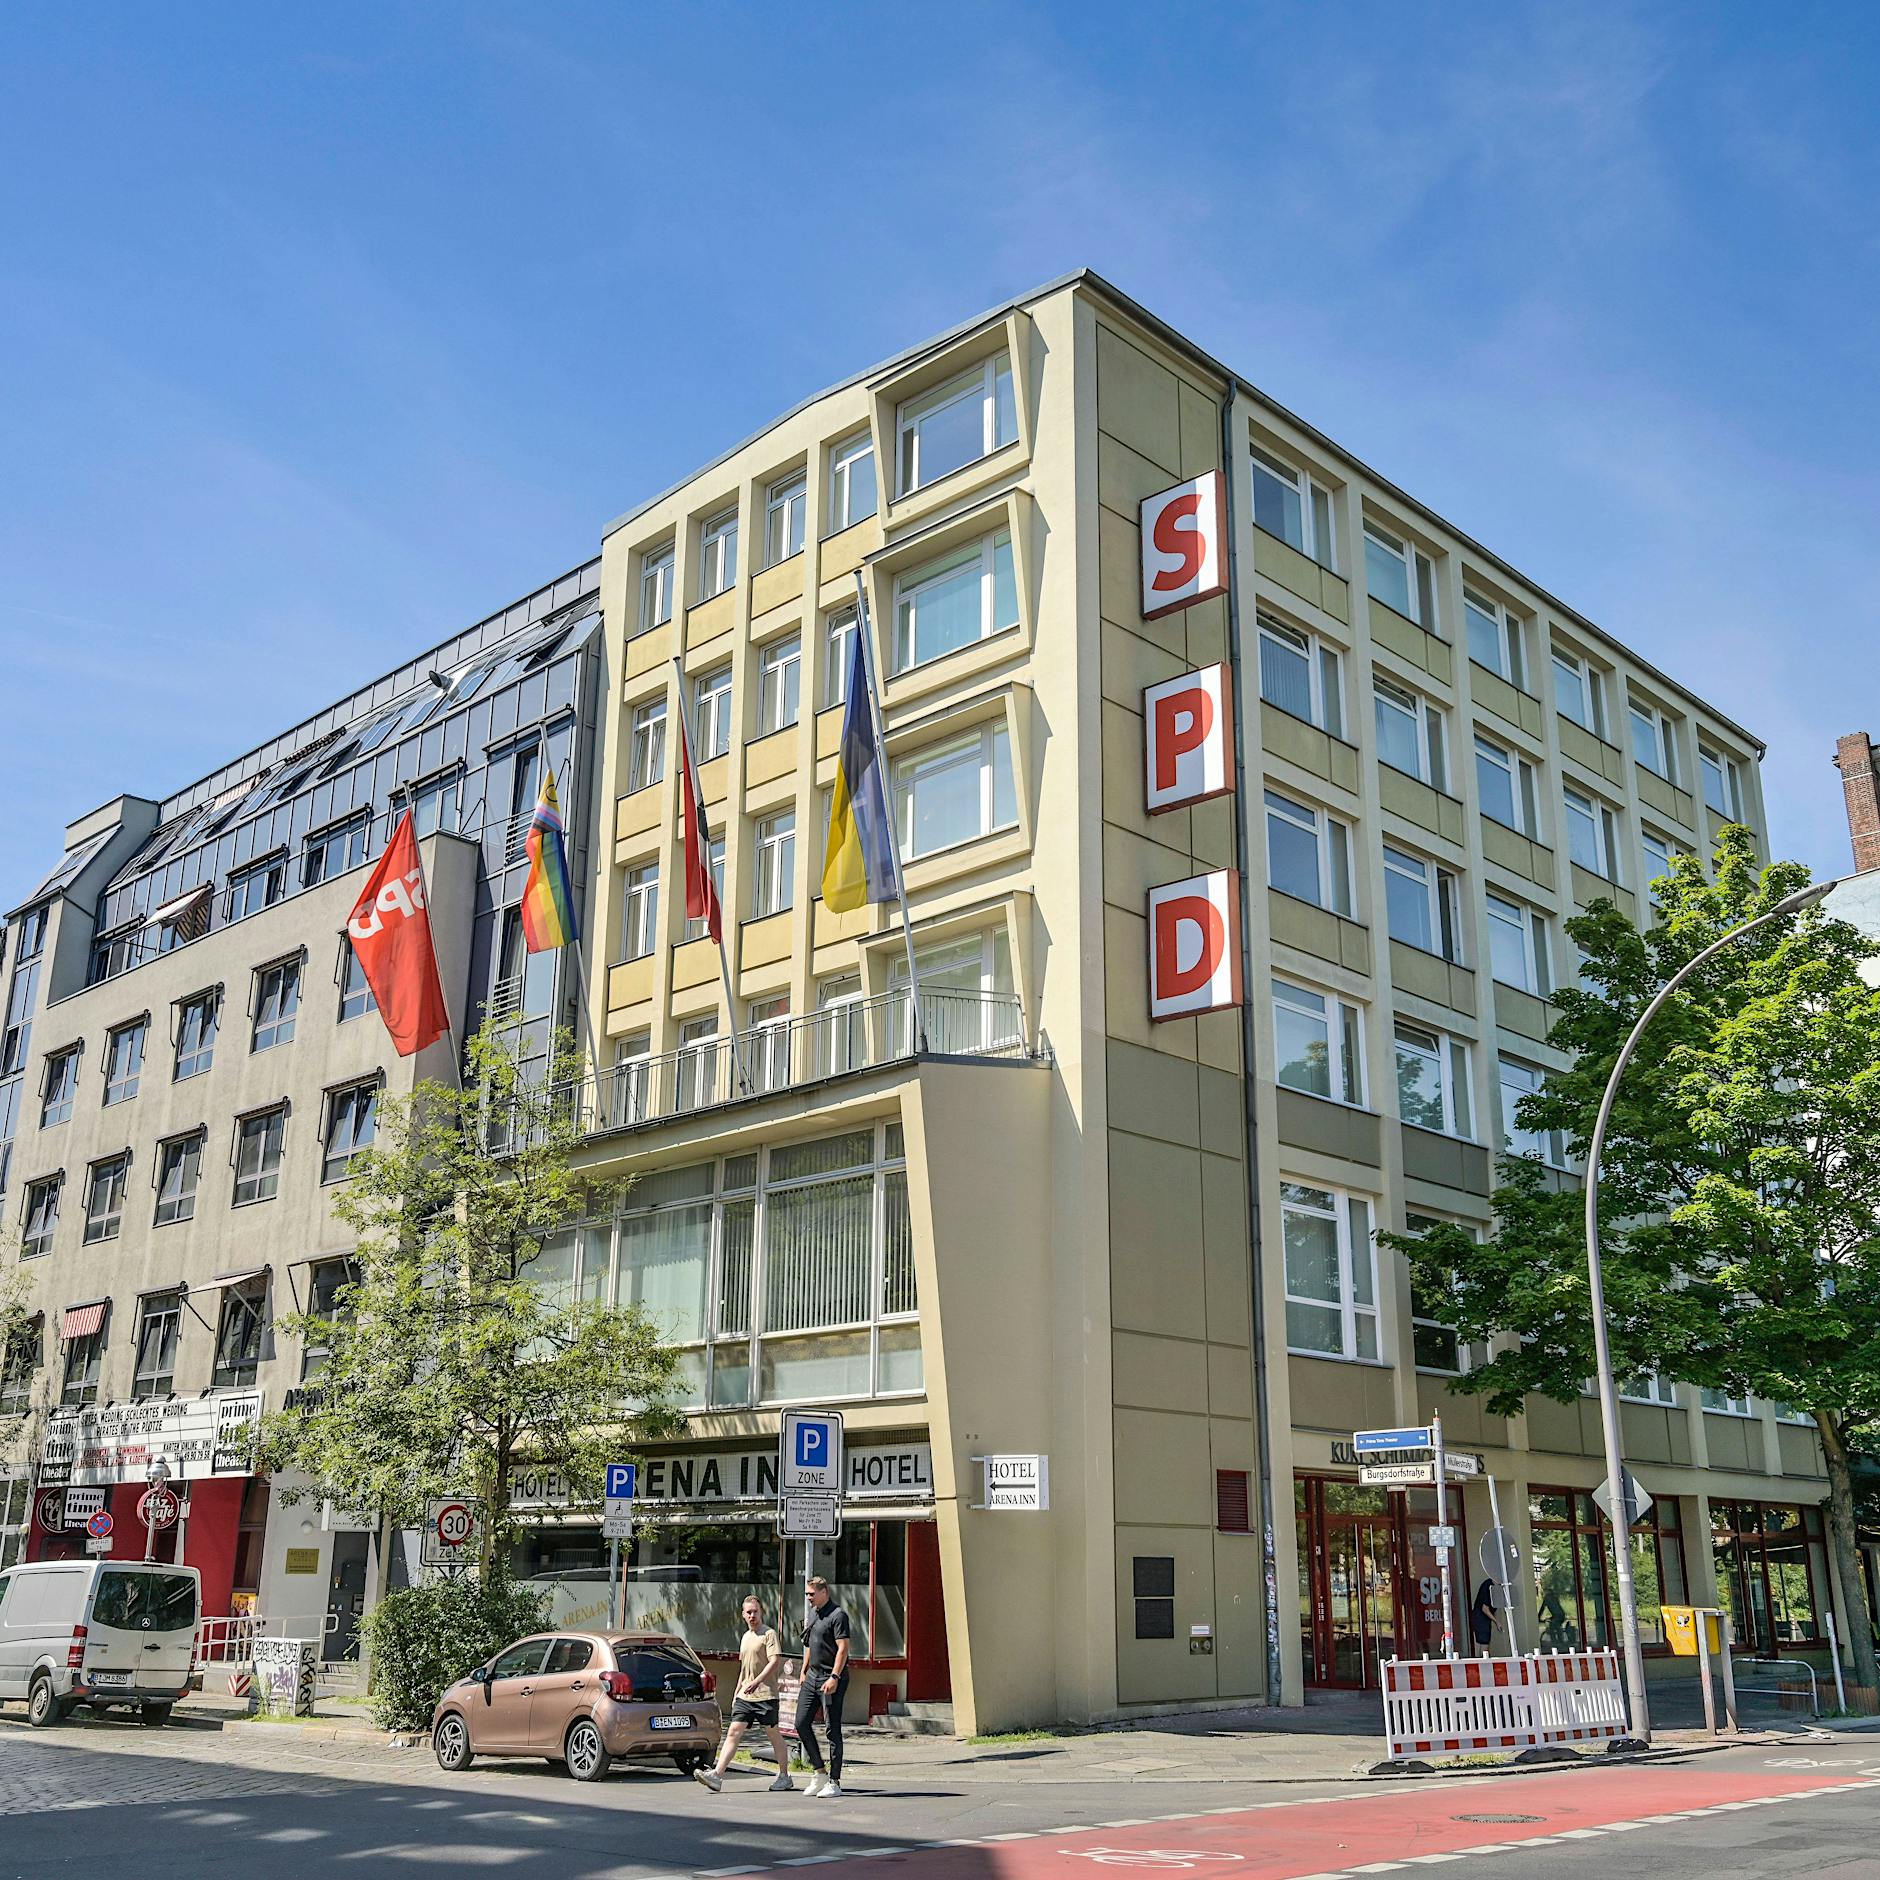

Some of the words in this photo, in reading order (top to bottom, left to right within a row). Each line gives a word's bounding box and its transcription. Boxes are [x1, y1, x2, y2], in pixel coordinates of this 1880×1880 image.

[162, 1403, 188, 1417] WEDDING
[220, 1401, 256, 1419] prime
[48, 1420, 76, 1436] prime
[46, 1440, 74, 1459] time
[803, 1428, 821, 1461] P
[215, 1453, 247, 1468] thea
[851, 1454, 927, 1486] HOTEL
[989, 1462, 1036, 1478] HOTEL
[1367, 1467, 1425, 1480] Burgsdorfstraße
[612, 1468, 629, 1495] P
[798, 1471, 825, 1485] ZONE
[69, 1492, 103, 1501] prime
[989, 1494, 1018, 1505] ARENA
[1019, 1494, 1036, 1505] INN
[67, 1502, 101, 1513] time
[64, 1520, 88, 1528] thea
[444, 1515, 466, 1534] 30
[1420, 1576, 1441, 1605] SP
[1424, 1609, 1444, 1622] BERL
[663, 1717, 673, 1727] EN
